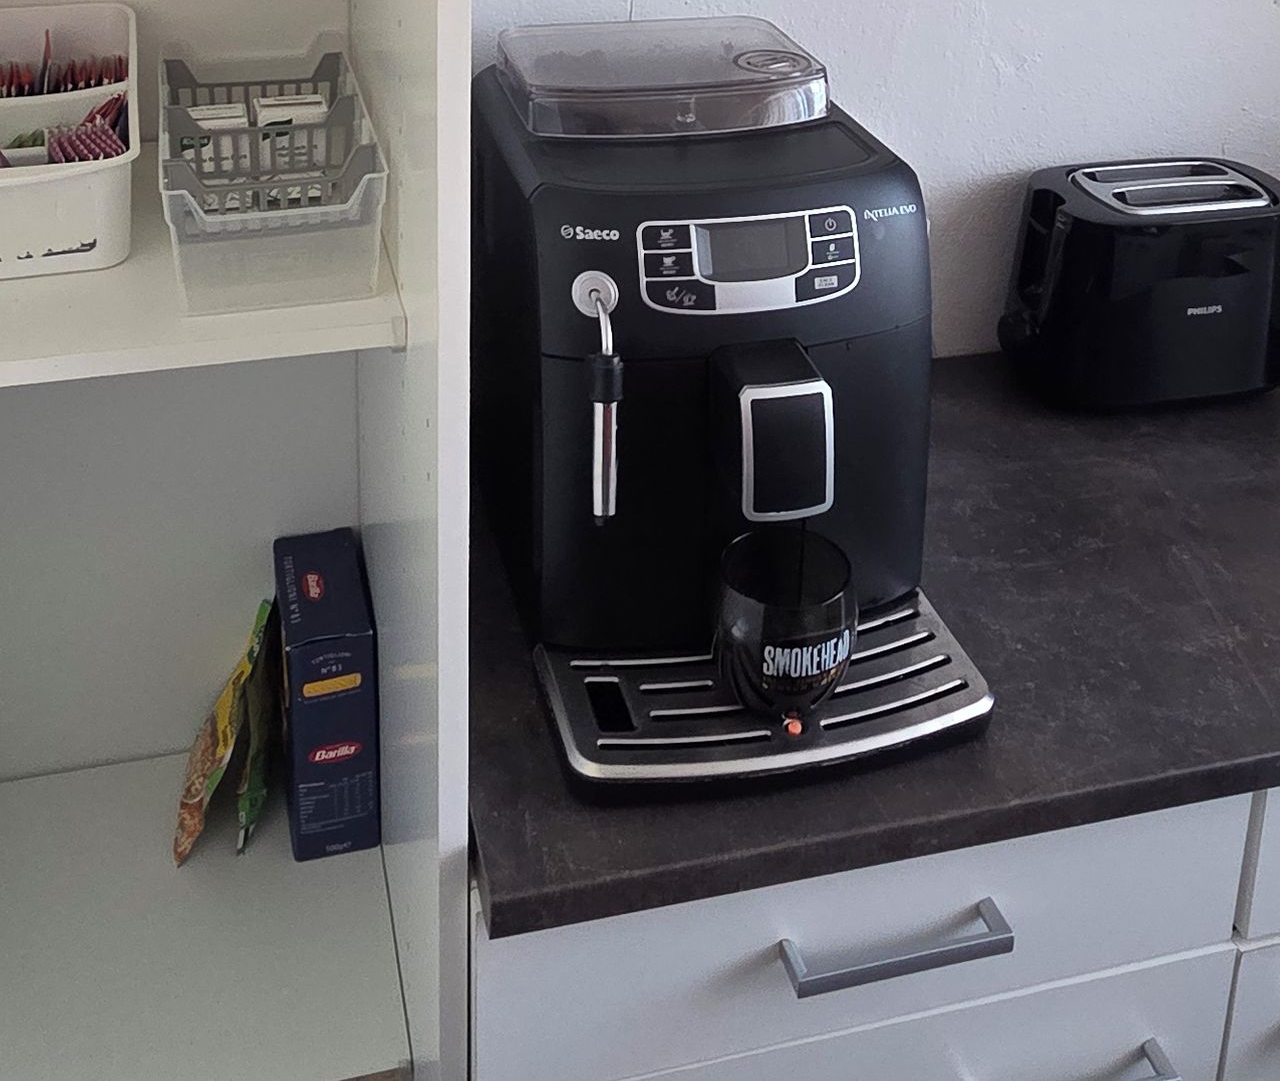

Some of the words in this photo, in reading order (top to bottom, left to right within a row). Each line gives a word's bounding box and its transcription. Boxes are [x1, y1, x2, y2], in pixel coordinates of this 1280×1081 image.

[899, 203, 918, 216] EVO
[575, 226, 620, 241] Saeco
[1187, 305, 1222, 316] PHILIPS
[762, 629, 851, 677] SMOKEHEAD
[314, 744, 357, 762] Barilla
